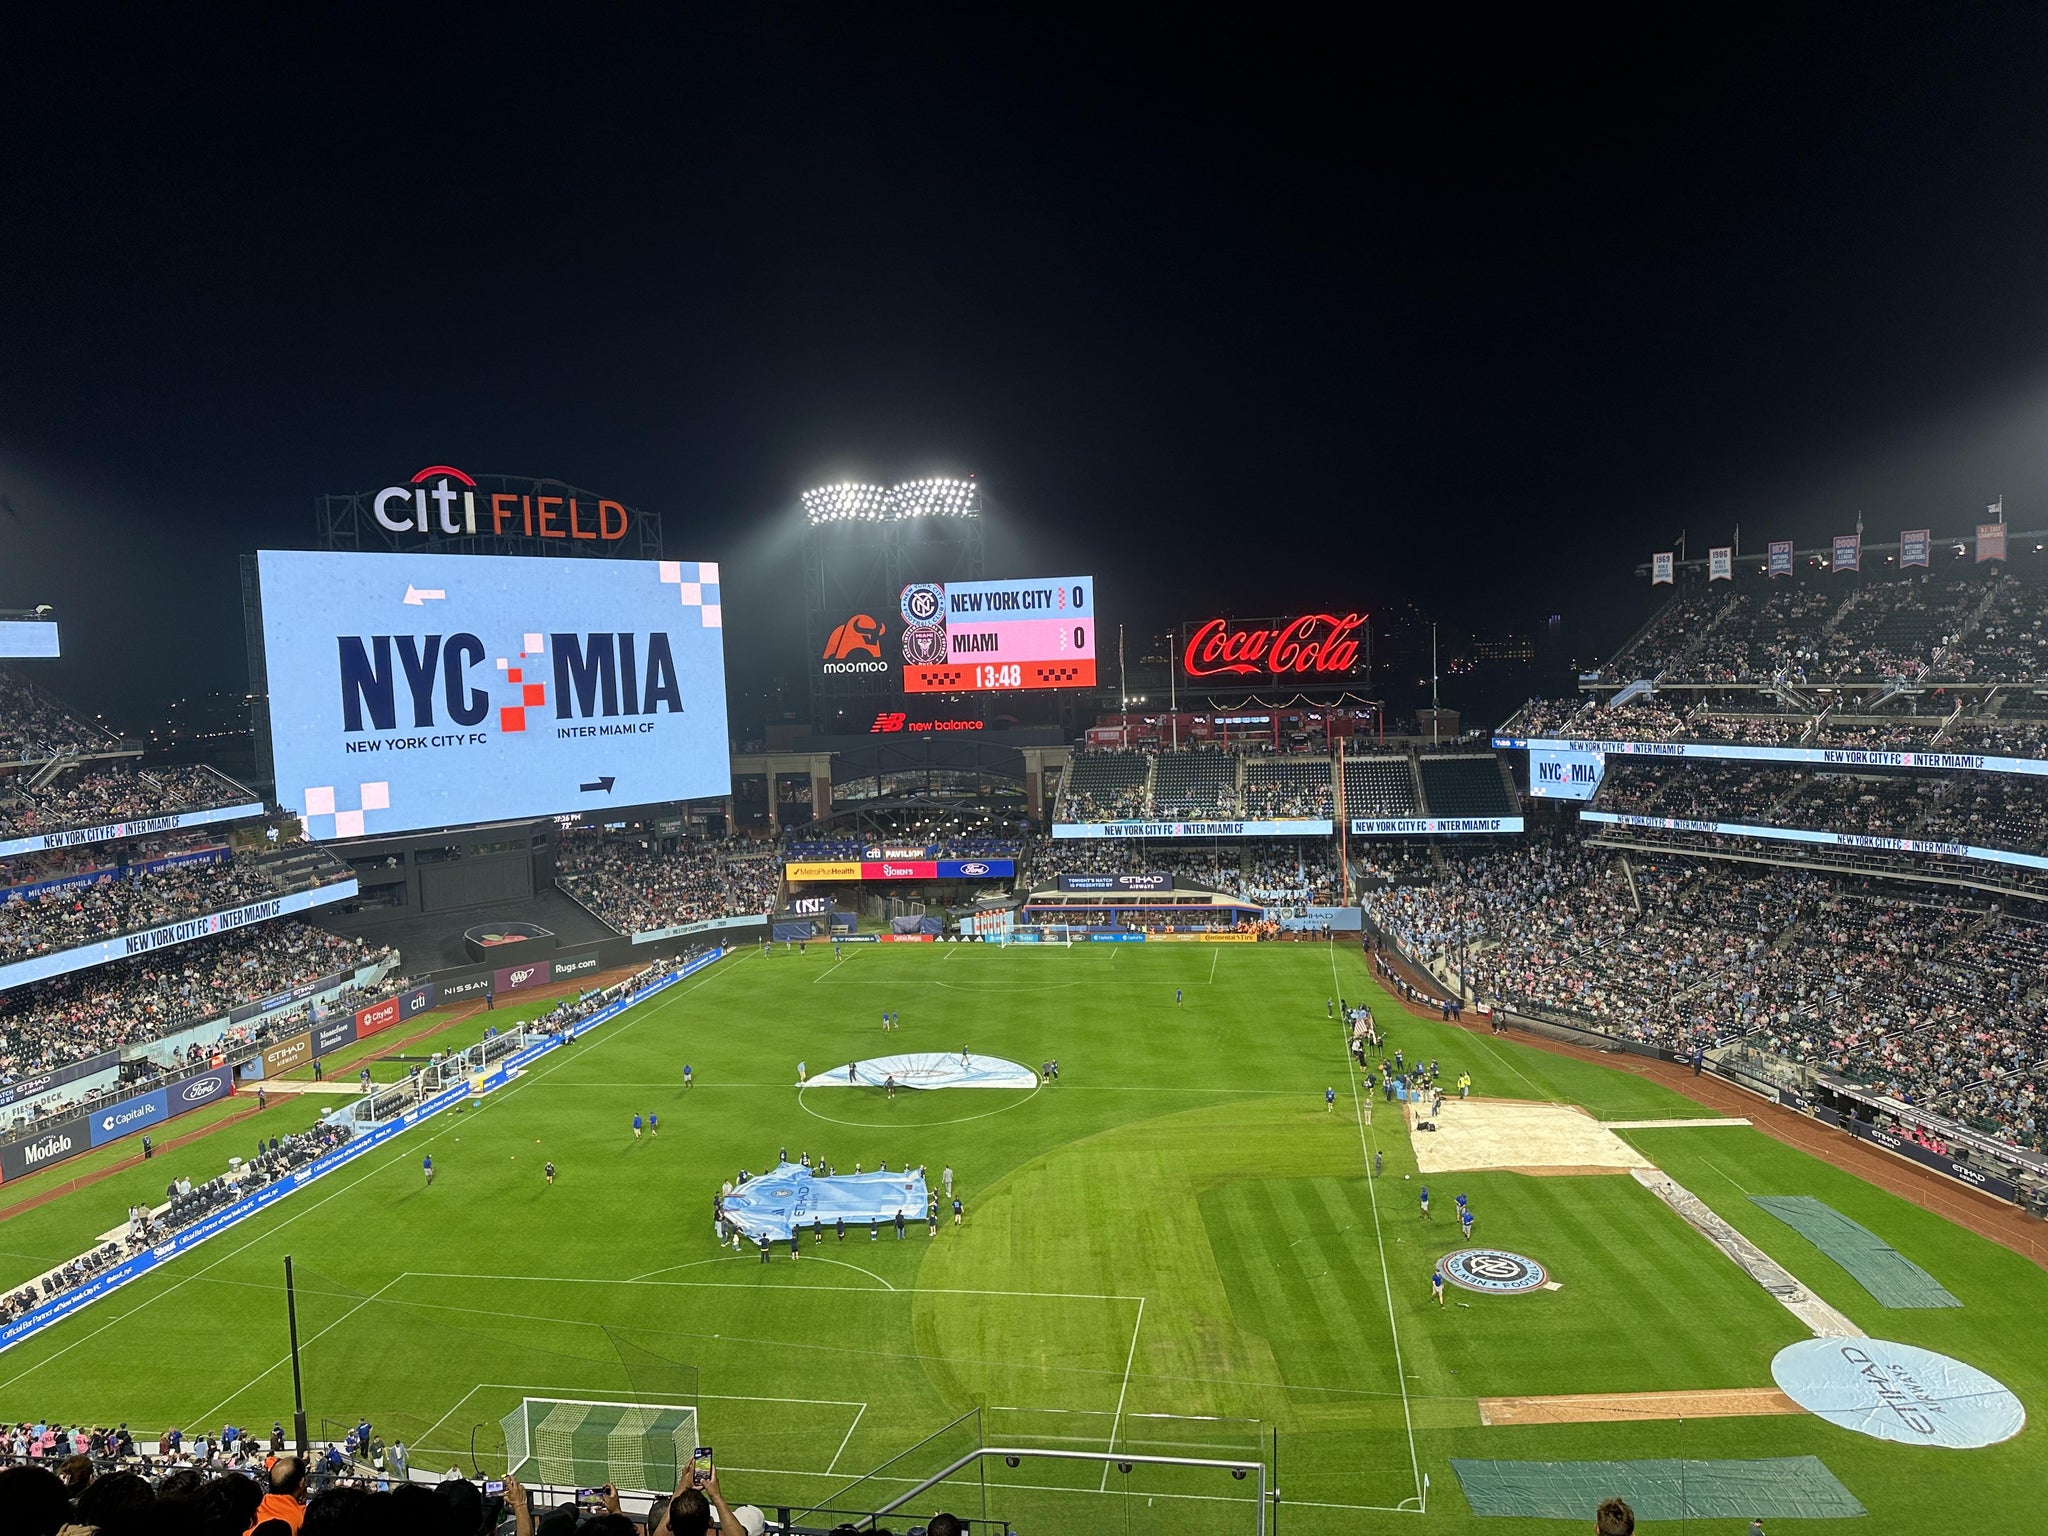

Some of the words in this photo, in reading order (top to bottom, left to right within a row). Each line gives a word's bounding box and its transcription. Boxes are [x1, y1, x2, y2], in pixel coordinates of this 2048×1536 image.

[374, 478, 476, 534] citi
[491, 494, 628, 540] FIELD
[1656, 555, 1671, 563] 1969
[1712, 550, 1728, 558] 1986
[951, 593, 982, 612] NEW
[984, 591, 1020, 611] YORK
[1022, 590, 1052, 610] CITY
[1072, 586, 1084, 608] 0
[952, 633, 998, 653] MIAMI
[1074, 626, 1085, 648] 0
[1184, 613, 1368, 676] Coca-Cola
[550, 632, 684, 720] MIA
[824, 661, 888, 674] moomoo
[336, 632, 488, 732] NYC
[975, 665, 1022, 688] 13:48
[557, 726, 596, 738] INTER
[599, 724, 636, 736] MIAMI
[639, 722, 654, 733] CF
[908, 722, 932, 732] new
[934, 720, 984, 731] balance
[346, 740, 382, 754] NEW
[385, 737, 427, 751] YORK
[431, 734, 466, 748] CITY
[470, 733, 487, 745] FC
[1570, 742, 1582, 750] NEW
[1584, 742, 1601, 751] YORK
[1602, 743, 1617, 752] CITY
[1617, 743, 1625, 752] FC
[1634, 744, 1652, 753] INTER
[1653, 745, 1676, 754] MIAMI
[1677, 746, 1685, 755] CF
[1824, 751, 1843, 762] NEW
[1846, 752, 1867, 763] YORK
[1869, 753, 1888, 764] CITY
[1890, 754, 1900, 765] FC
[1914, 755, 1940, 766] INTER
[1942, 756, 1973, 767] MIAMI
[1975, 757, 1984, 768] CF
[1539, 762, 1561, 780] NYC
[1572, 765, 1596, 782] MIA
[1104, 825, 1123, 835] NEW
[1124, 825, 1144, 835] YORK
[1146, 825, 1162, 835] CITY
[1164, 824, 1173, 834] FC
[1184, 824, 1206, 834] INTER
[1207, 824, 1234, 834] MIAMI
[1235, 823, 1244, 833] CF
[1356, 822, 1374, 832] NEW
[1376, 822, 1397, 831] YORK
[1398, 821, 1416, 831] CITY
[1417, 821, 1426, 831] FC
[1438, 821, 1460, 830] INTER
[1462, 820, 1489, 830] MIAMI
[1491, 820, 1500, 830] CF
[1618, 815, 1631, 823] NEW
[1632, 816, 1645, 824] YORK
[1646, 817, 1658, 826] CITY
[1659, 818, 1666, 826] FC
[1673, 819, 1690, 828] INTER
[1691, 821, 1710, 830] MIAMI
[1712, 822, 1719, 831] CF
[44, 834, 63, 848] NEW
[64, 831, 86, 845] YORK
[88, 828, 104, 842] CITY
[106, 826, 115, 838] FC
[126, 822, 146, 836] INTER
[147, 819, 171, 832] MIAMI
[172, 816, 180, 827] CF
[866, 848, 881, 859] citi
[886, 850, 924, 858] PAVILION
[1838, 835, 1854, 844] NEW
[1856, 836, 1873, 846] YORK
[1875, 838, 1891, 847] CITY
[1893, 840, 1901, 849] FC
[1912, 841, 1934, 851] INTER
[1935, 843, 1960, 854] MIAMI
[1962, 845, 1968, 856] CF
[800, 866, 855, 876] MetroPlusHealth
[964, 865, 984, 874] Ford
[28, 886, 60, 898] MILAGRO
[63, 879, 92, 890] TEQUILA
[1119, 876, 1163, 884] ETIHAD
[126, 934, 148, 954] NEW
[151, 927, 175, 947] YORK
[176, 923, 196, 940] CITY
[198, 919, 208, 934] FC
[219, 912, 243, 929] INTER
[244, 905, 271, 923] MIAMI
[272, 900, 280, 915] CF
[555, 959, 596, 974] Rugs.com
[294, 984, 315, 996] ETIHAD
[444, 980, 488, 995] NISSAN
[411, 994, 425, 1011] citi
[372, 1007, 393, 1020] CityMD
[320, 1023, 348, 1040] Montefiore
[321, 1035, 342, 1048] Einstein
[268, 1042, 305, 1062] ETIHAD
[277, 1054, 298, 1066] AIRWAYS
[16, 1076, 51, 1092] ETIHAD
[24, 1085, 44, 1096] AIRWAYS
[190, 1081, 214, 1098] Ford
[41, 1092, 63, 1104] DECK
[116, 1106, 144, 1125] Capital
[145, 1104, 156, 1113] Rx
[1871, 1129, 1900, 1146] ETIHAD
[1878, 1139, 1895, 1149] AIRWAYS
[24, 1134, 72, 1165] Modelo
[1952, 1163, 1986, 1182] ETIHAD
[1959, 1174, 1978, 1185] AIRWAYS
[794, 1186, 809, 1216] ETIHAD
[153, 1240, 176, 1259] Stout
[1460, 1274, 1487, 1286] NEW
[2, 1324, 22, 1340] Official
[22, 1319, 32, 1330] Bar
[33, 1310, 53, 1325] Partner
[93, 1283, 102, 1291] FC
[1840, 1346, 1936, 1434] ETIHAD
[1887, 1364, 1946, 1414] AIRWAYS
